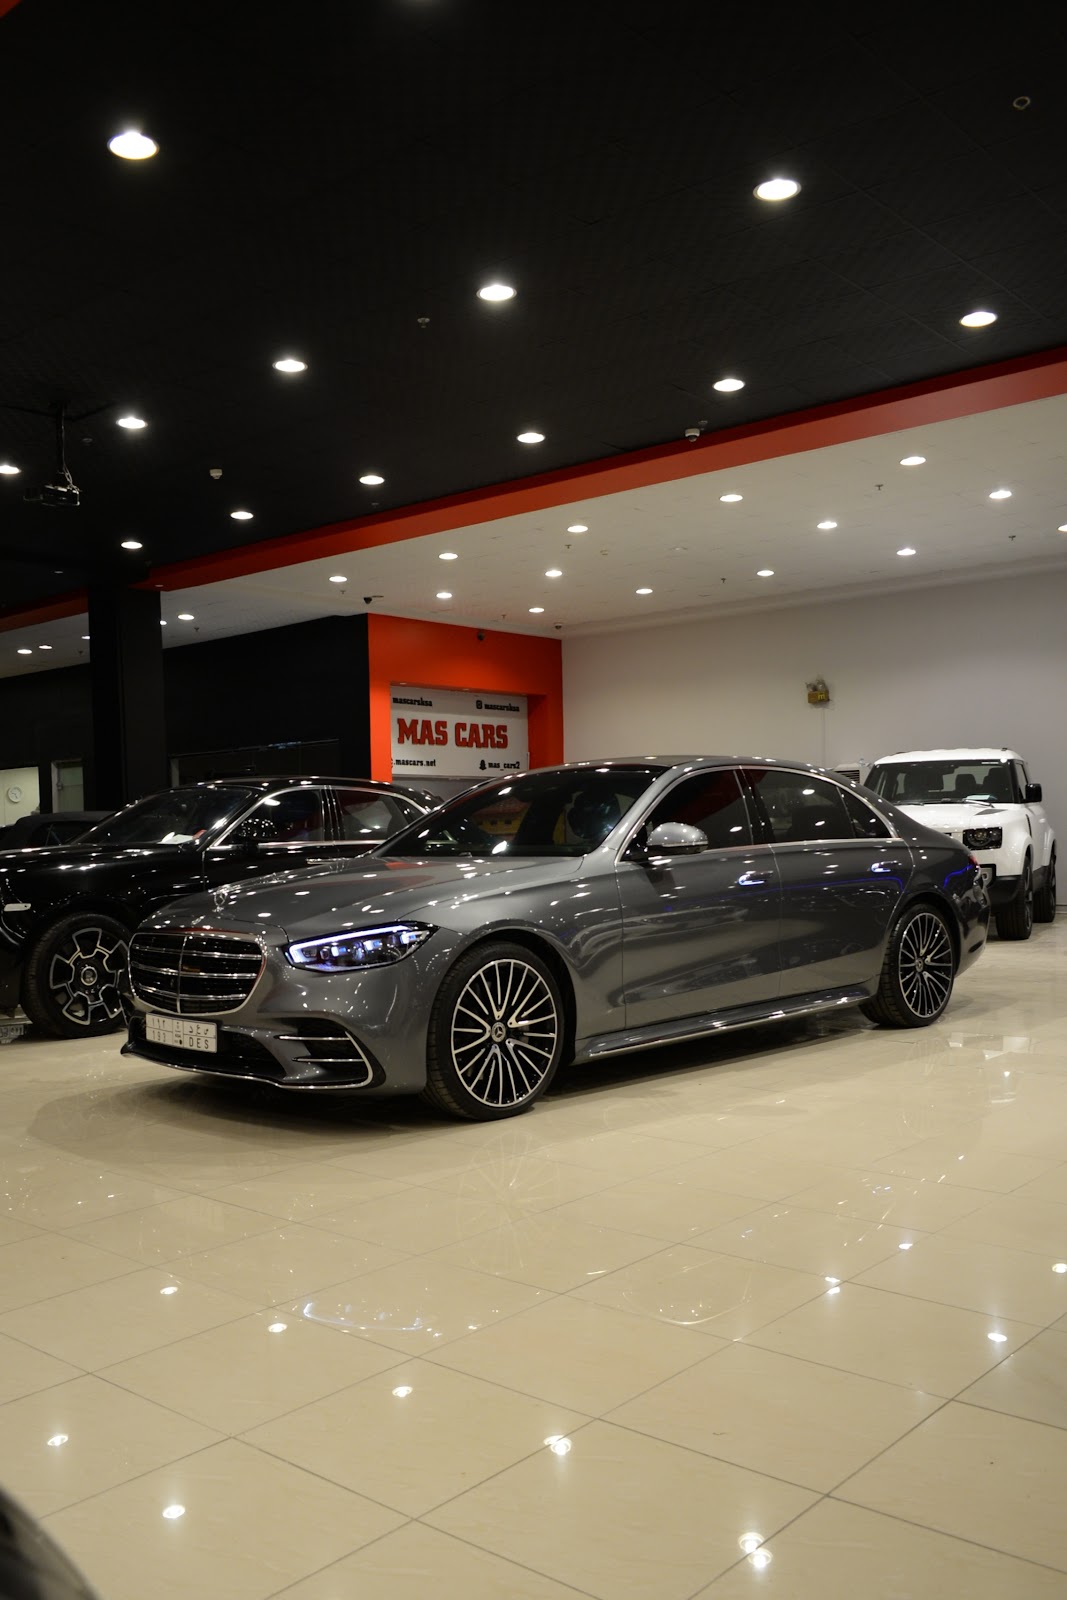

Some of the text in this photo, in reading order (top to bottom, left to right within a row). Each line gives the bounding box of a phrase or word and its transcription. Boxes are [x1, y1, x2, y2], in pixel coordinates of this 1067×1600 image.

[397, 718, 508, 749] MAS CARS
[189, 1036, 209, 1050] DES
